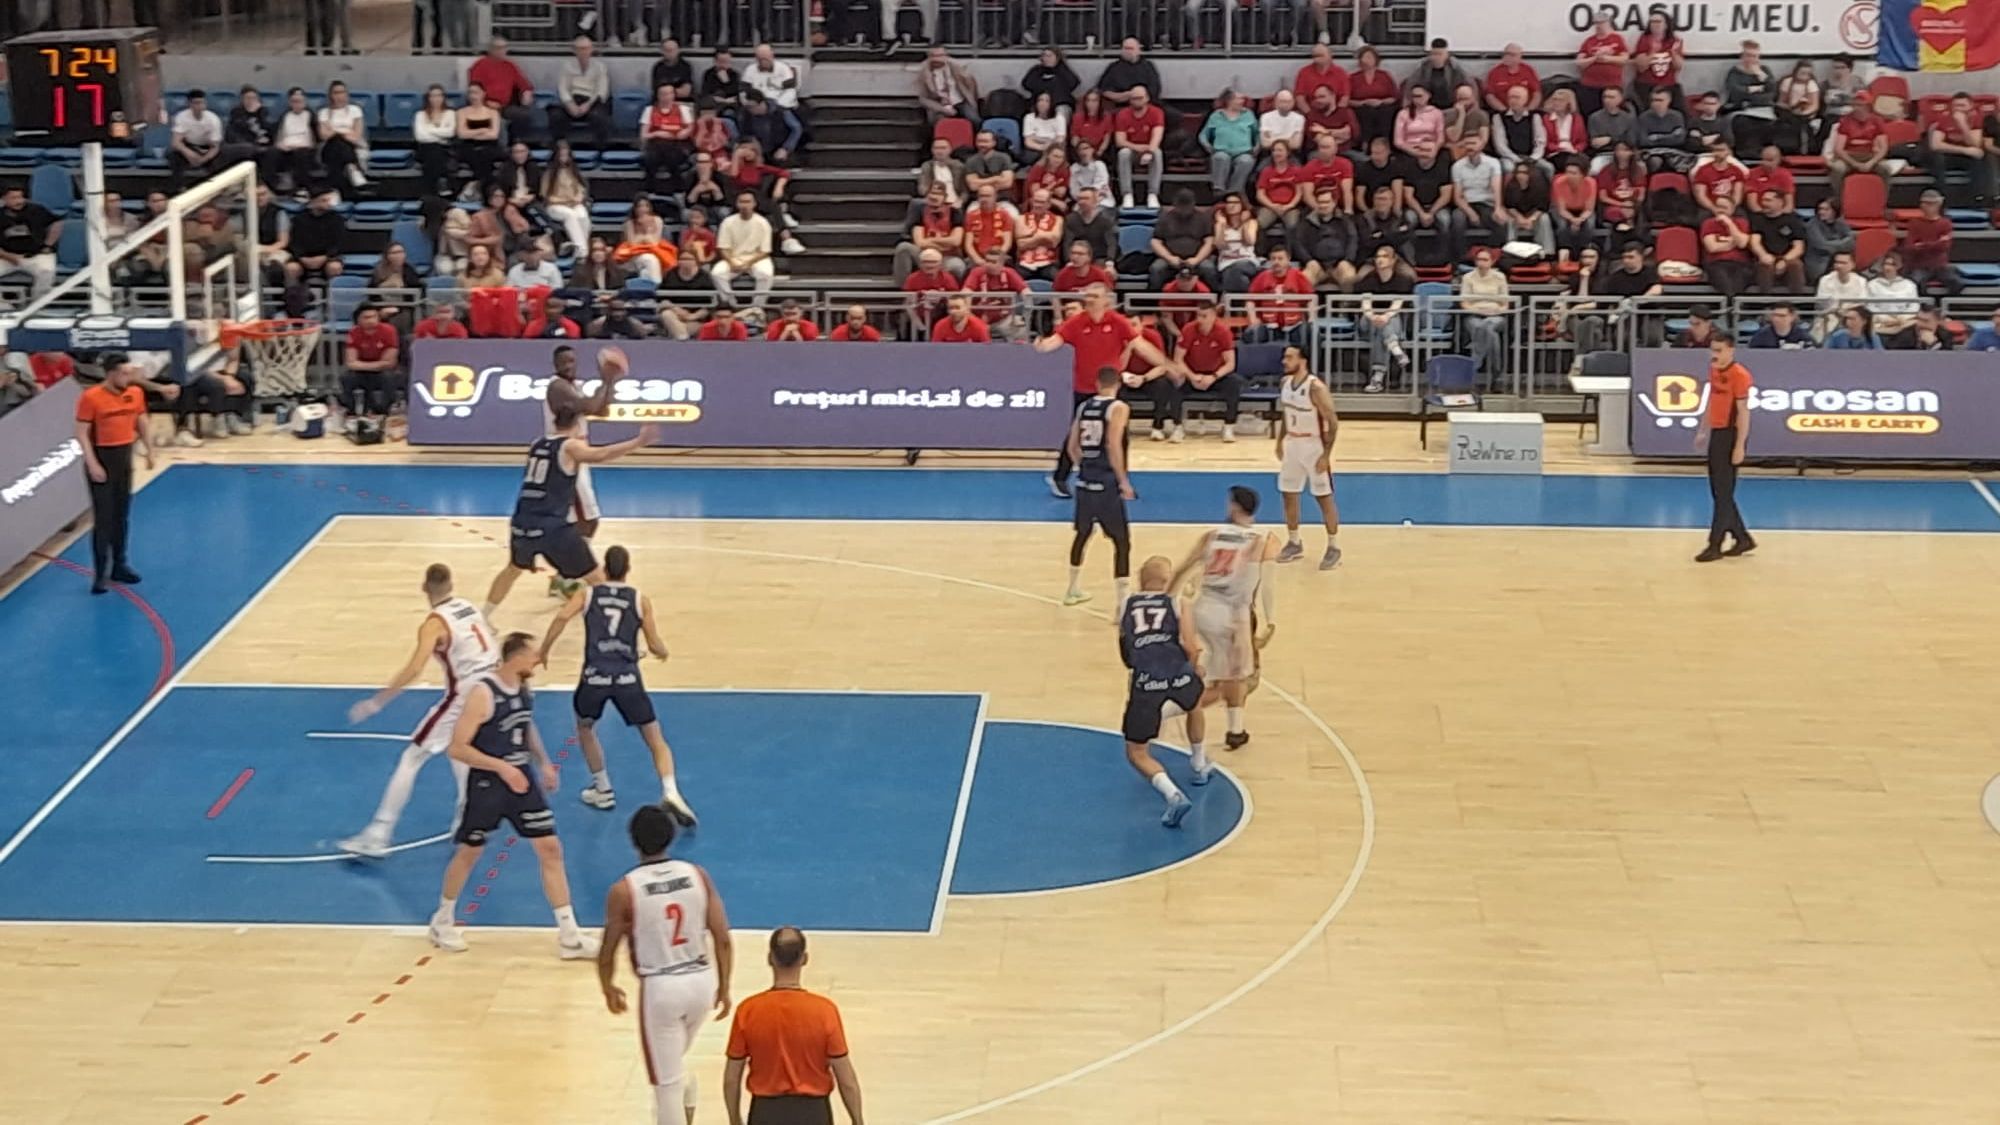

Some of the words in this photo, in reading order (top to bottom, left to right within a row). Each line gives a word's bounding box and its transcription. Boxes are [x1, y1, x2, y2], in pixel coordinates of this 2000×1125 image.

[1730, 3, 1820, 33] MEU.
[53, 84, 105, 127] 17
[966, 390, 1005, 408] de
[1009, 390, 1046, 408] zi!
[1799, 418, 1846, 428] CASH
[1851, 418, 1862, 429] &
[1867, 419, 1926, 429] CARRY
[603, 607, 622, 637] 7
[1130, 606, 1168, 635] 17
[470, 623, 489, 653] 1
[664, 902, 689, 947] 2
